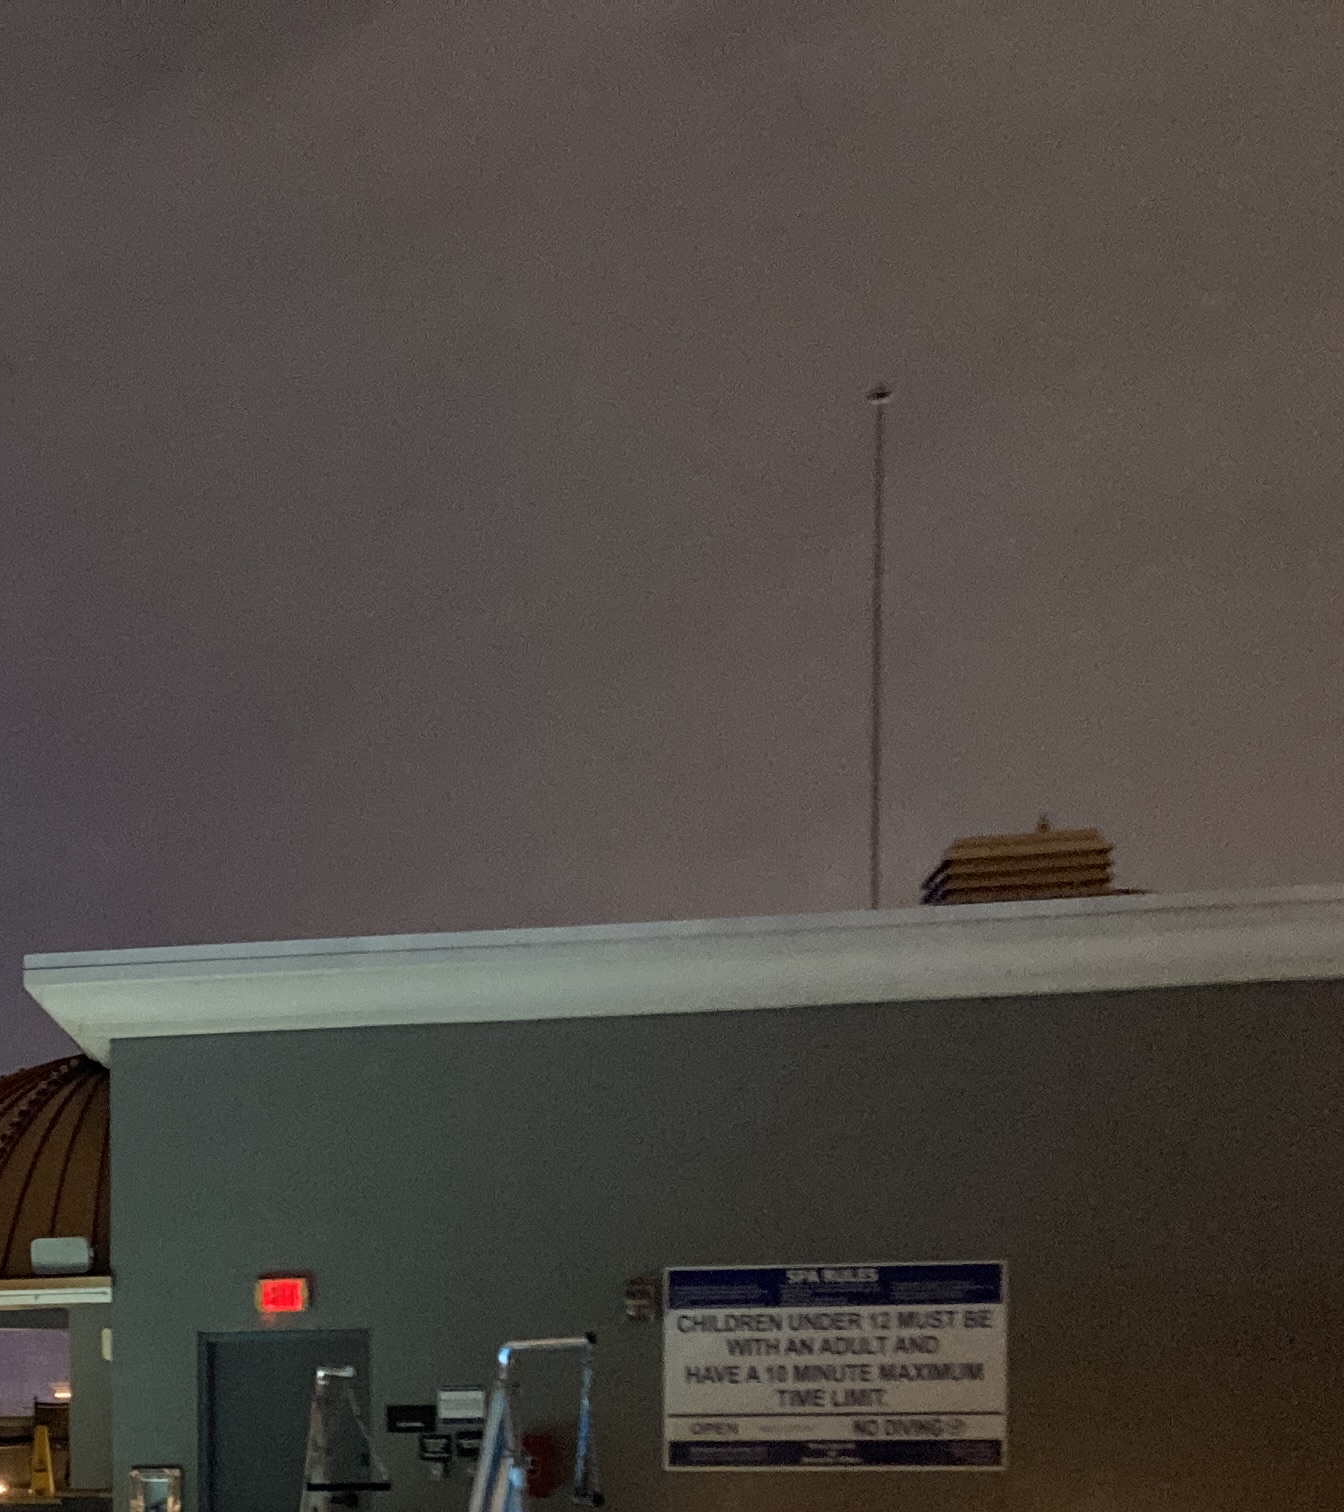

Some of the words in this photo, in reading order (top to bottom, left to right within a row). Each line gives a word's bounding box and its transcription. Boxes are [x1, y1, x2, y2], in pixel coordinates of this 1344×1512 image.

[677, 1313, 783, 1332] CHILDREN
[788, 1311, 861, 1331] UNDER
[897, 1310, 957, 1329] MUST
[964, 1309, 993, 1328] BE
[726, 1338, 781, 1356] WITH
[784, 1337, 814, 1355] AN
[819, 1336, 888, 1355] ADULT
[895, 1335, 939, 1354] AND
[685, 1365, 740, 1384] HAVE
[746, 1365, 761, 1383] A
[793, 1363, 873, 1382] MINUTE
[879, 1362, 985, 1381] MAXIMUM
[776, 1388, 825, 1407] TIME
[830, 1387, 886, 1406] LIMIT
